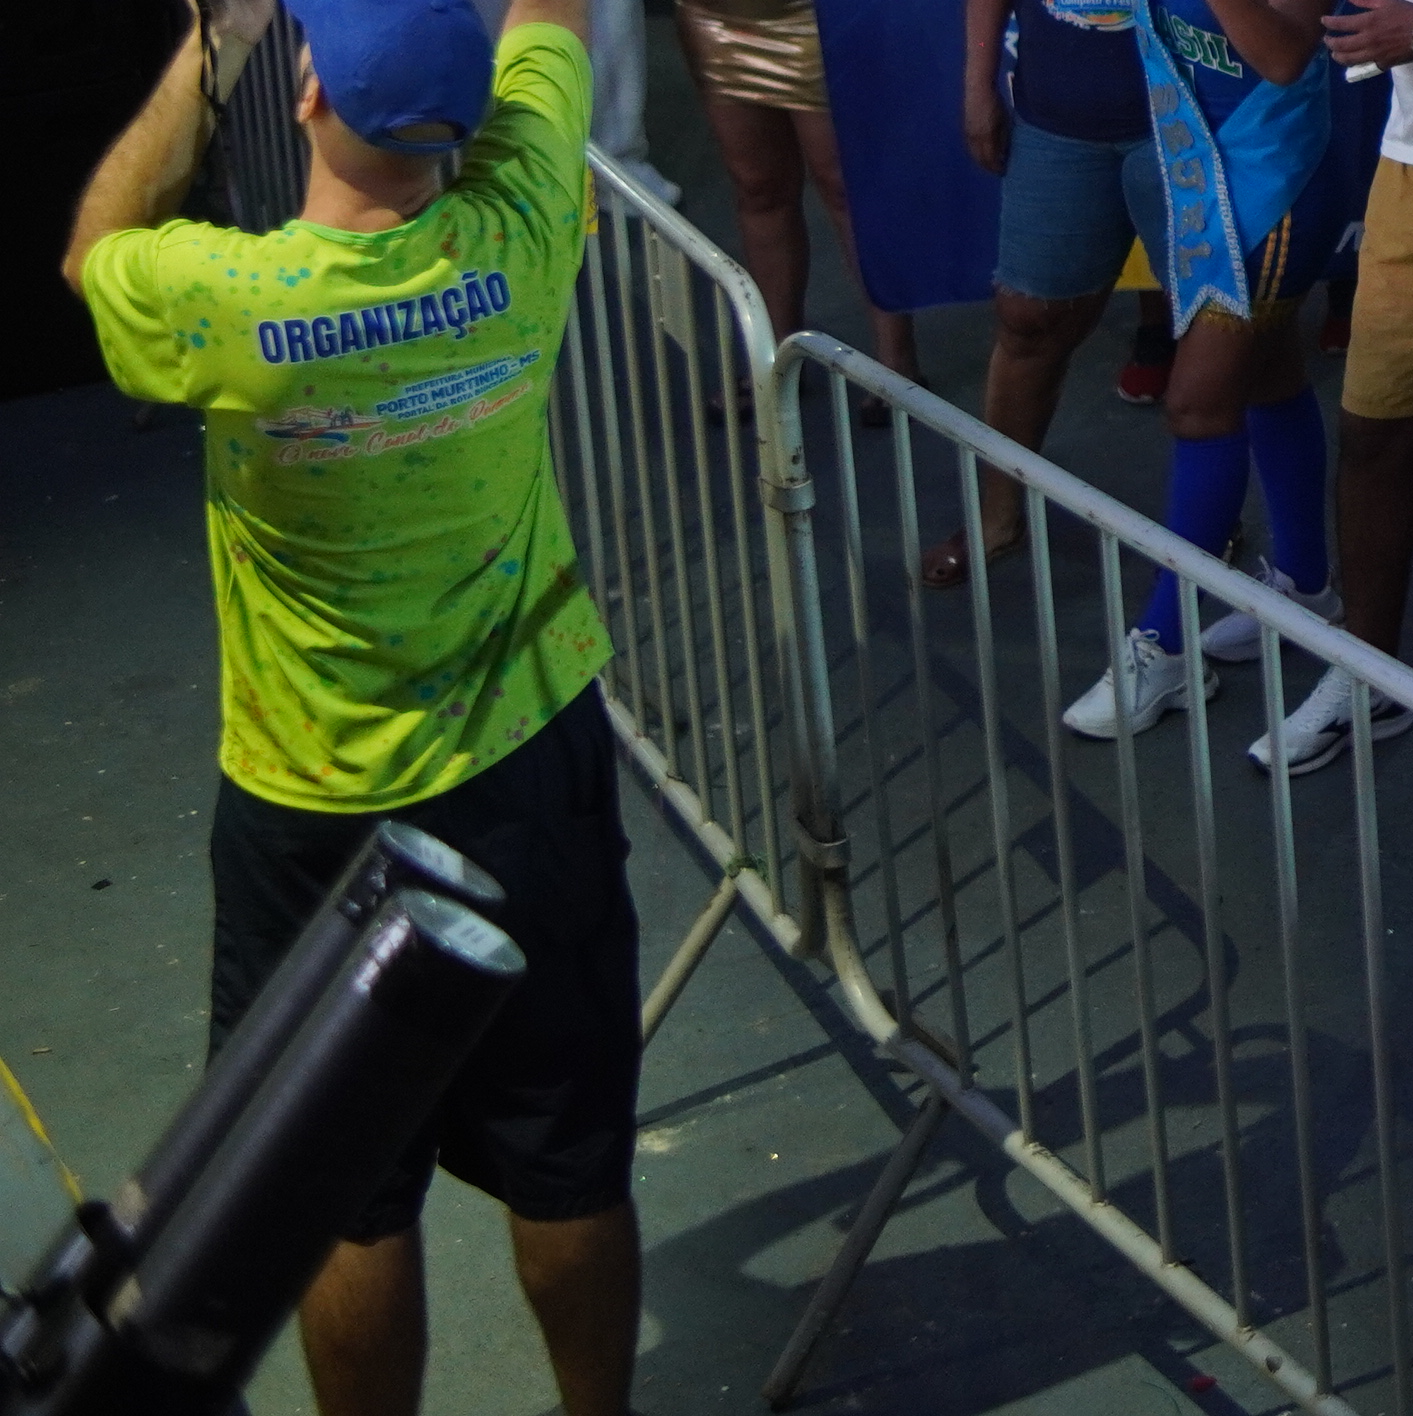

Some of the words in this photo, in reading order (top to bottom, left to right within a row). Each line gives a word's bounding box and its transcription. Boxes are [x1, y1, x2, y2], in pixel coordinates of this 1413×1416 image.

[258, 269, 511, 365] ORGANIZAÇÃO
[375, 391, 430, 416] PORTO
[431, 362, 509, 401] MURTINHO
[519, 349, 541, 366] MS
